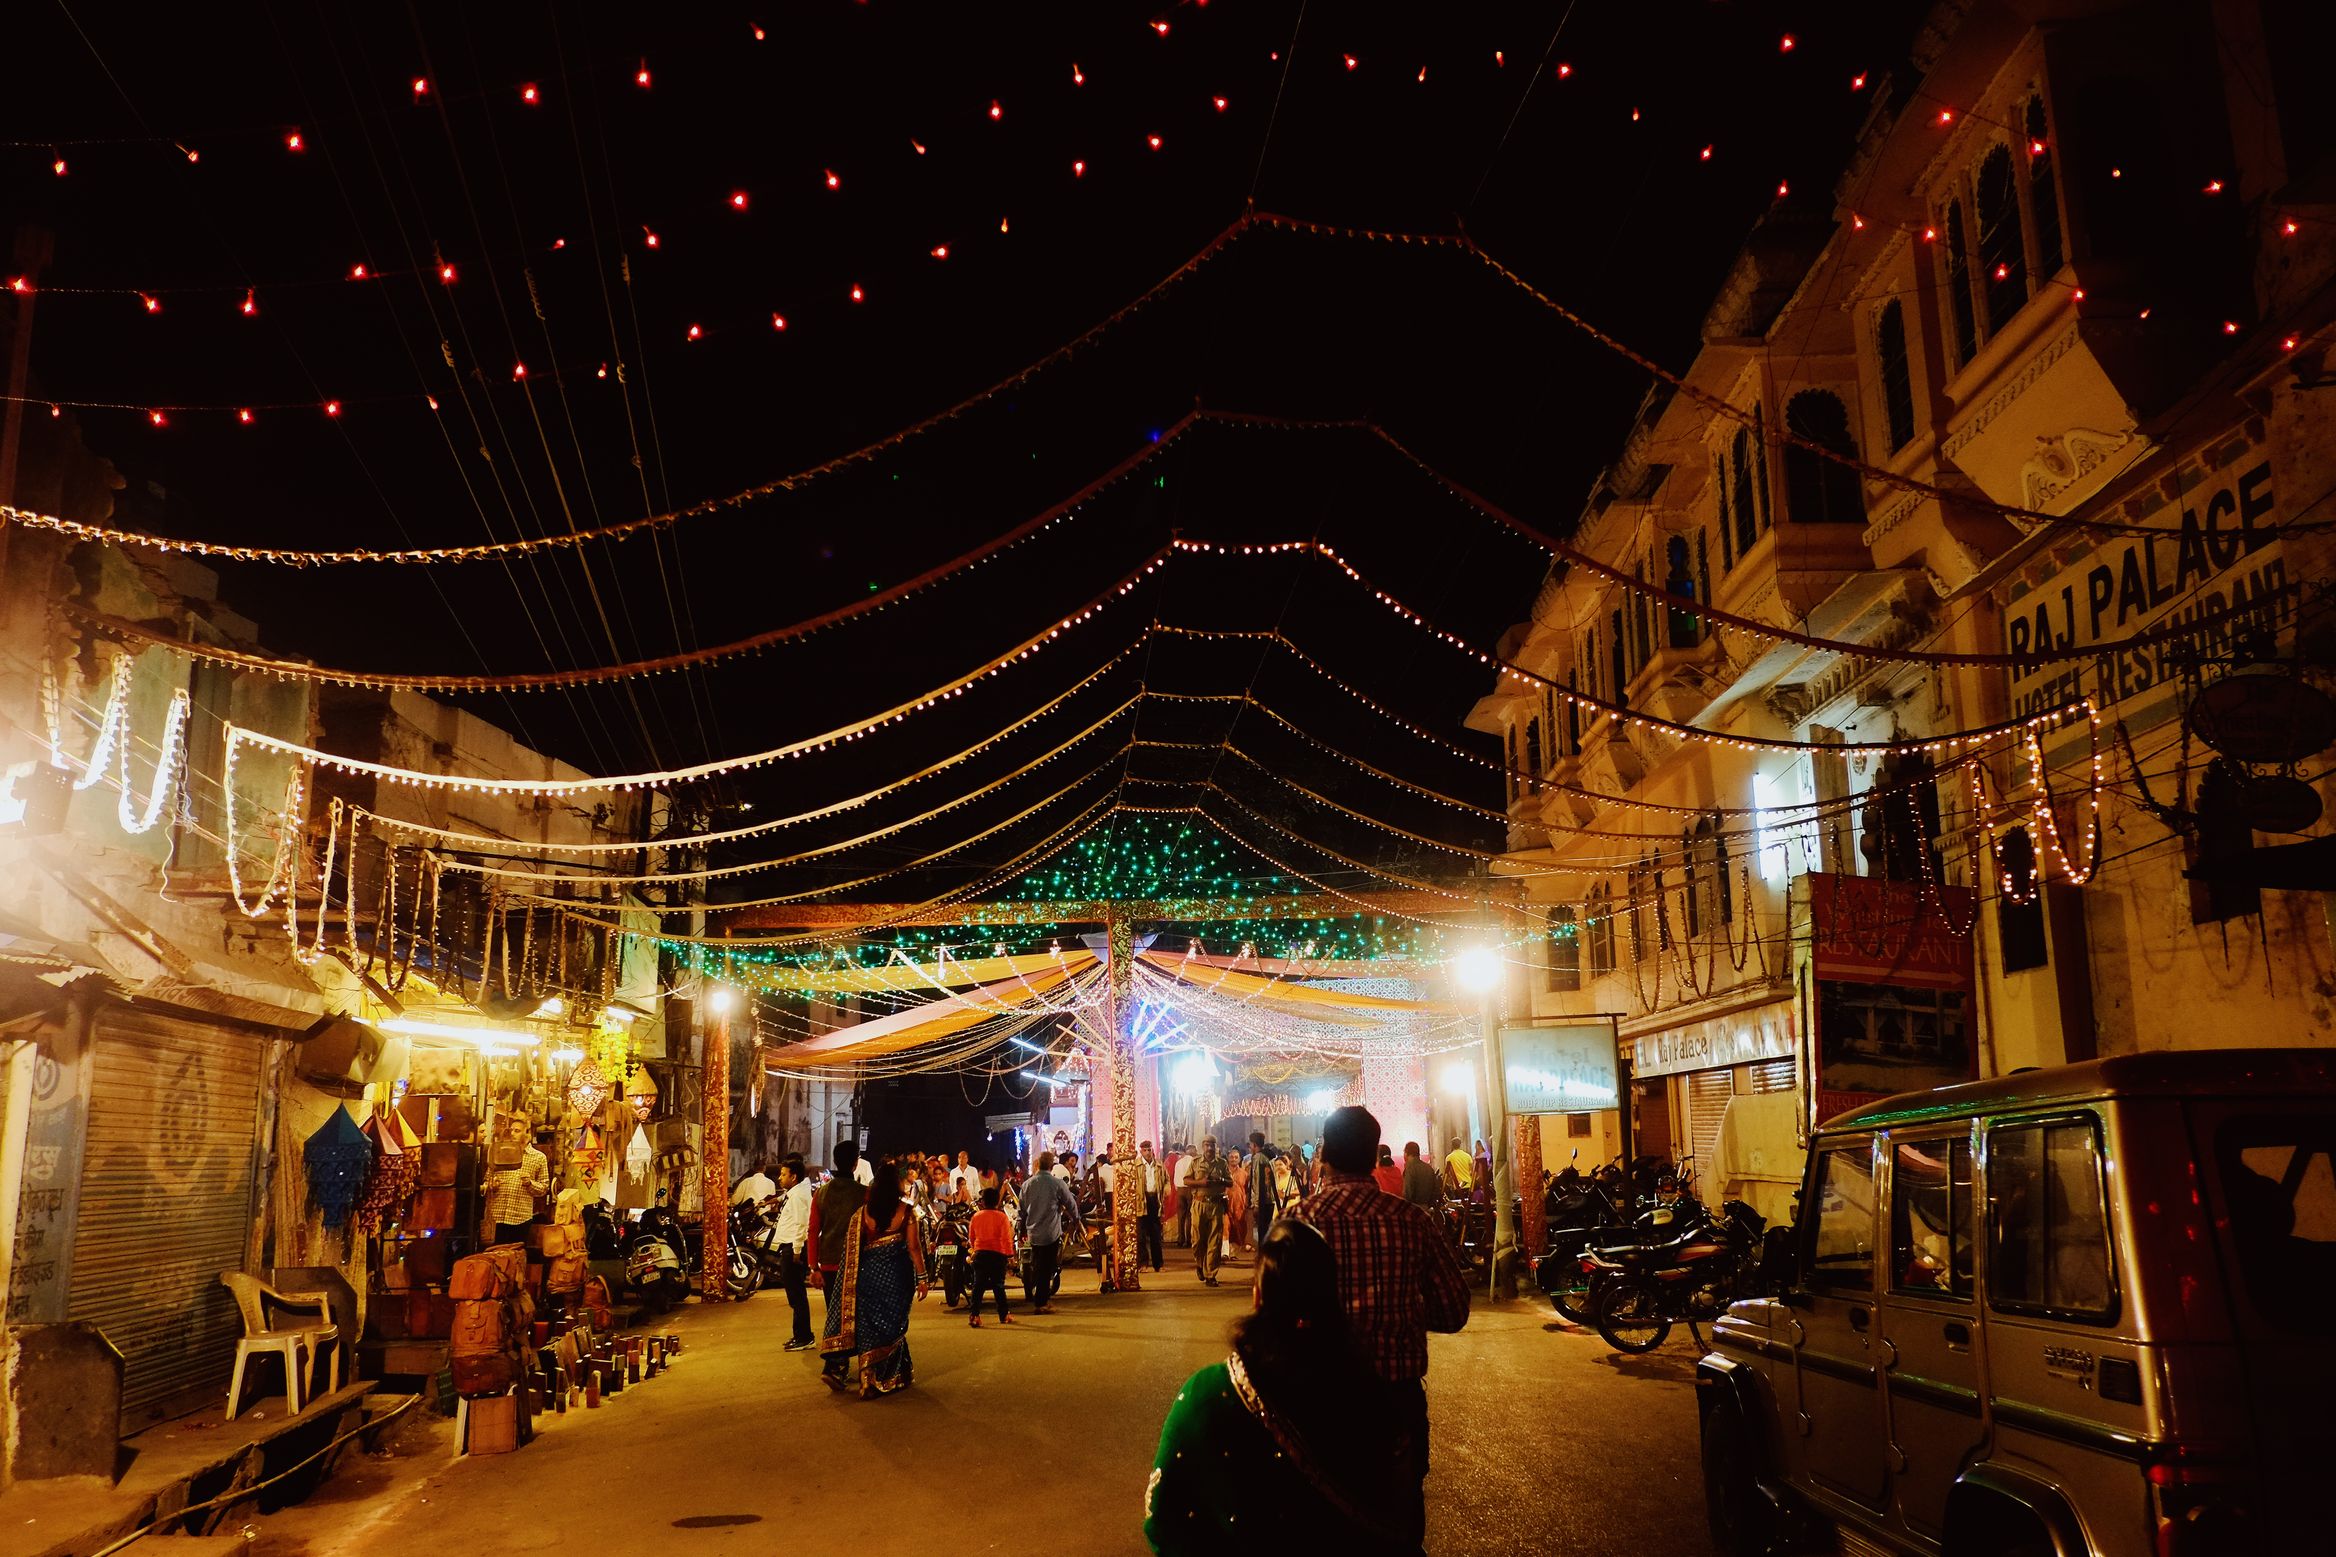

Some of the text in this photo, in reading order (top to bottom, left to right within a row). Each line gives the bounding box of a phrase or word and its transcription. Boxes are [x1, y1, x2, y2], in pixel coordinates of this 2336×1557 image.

[2010, 461, 2281, 683] RAJ PALACE
[1657, 1037, 1672, 1067] Raj
[1673, 1032, 1708, 1061] Palace
